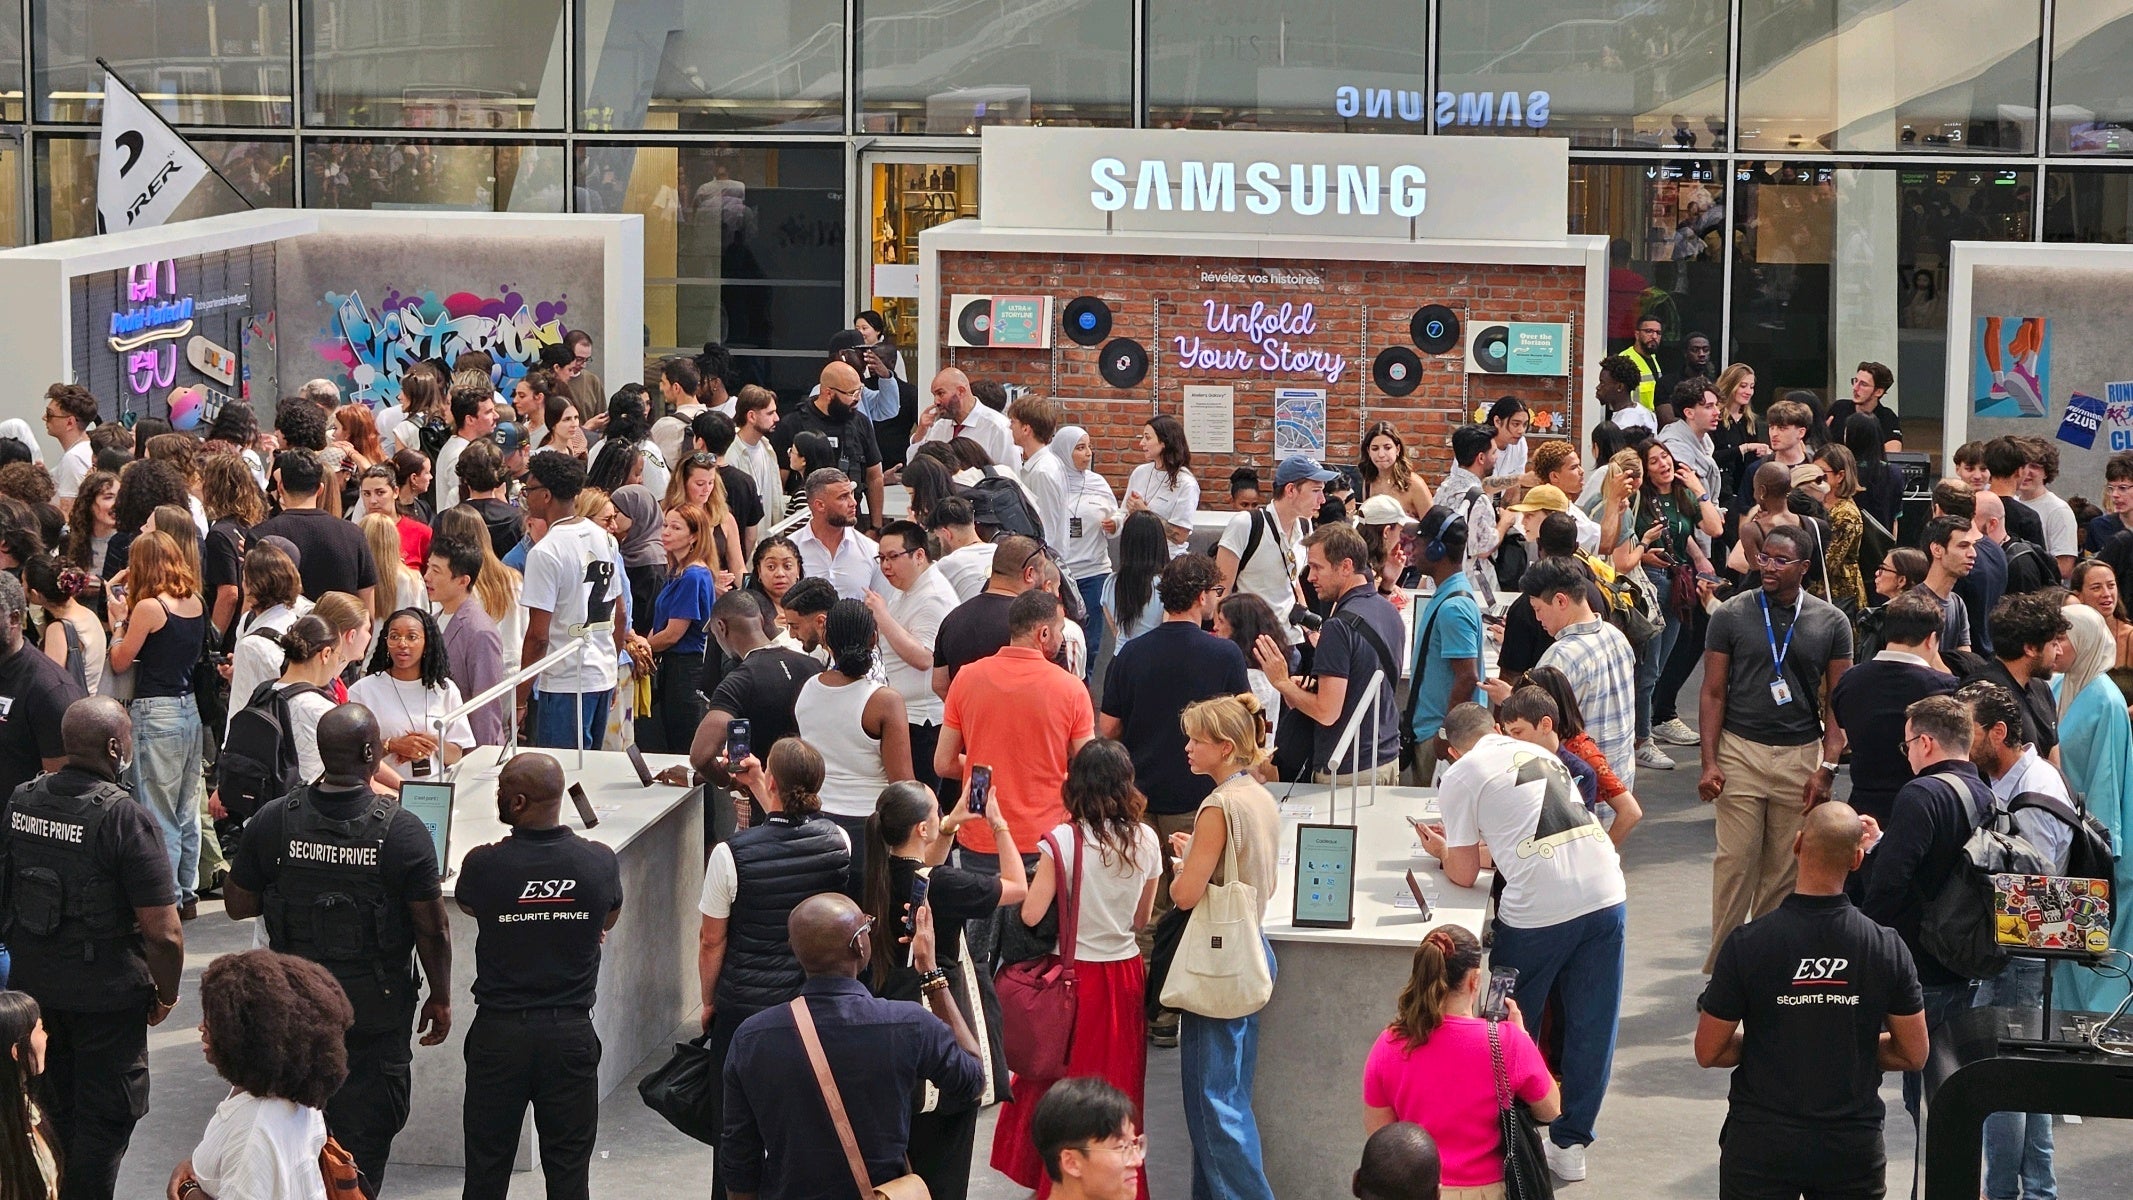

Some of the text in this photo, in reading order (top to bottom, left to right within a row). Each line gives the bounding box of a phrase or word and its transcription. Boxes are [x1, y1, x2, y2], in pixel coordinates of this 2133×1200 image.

[1090, 158, 1427, 217] SAMSUNG
[1200, 271, 1320, 285] Révélez vos histoires
[1203, 299, 1317, 344] Unfold
[1430, 323, 1439, 335] 7
[1539, 333, 1552, 341] the
[1174, 335, 1346, 384] Your Story
[2065, 412, 2097, 431] CLUB
[11, 811, 84, 844] SECURITE PRIVEE
[289, 840, 377, 866] SECURITE PRIVEE
[518, 879, 577, 899] ESP
[1792, 957, 1849, 980] ESP
